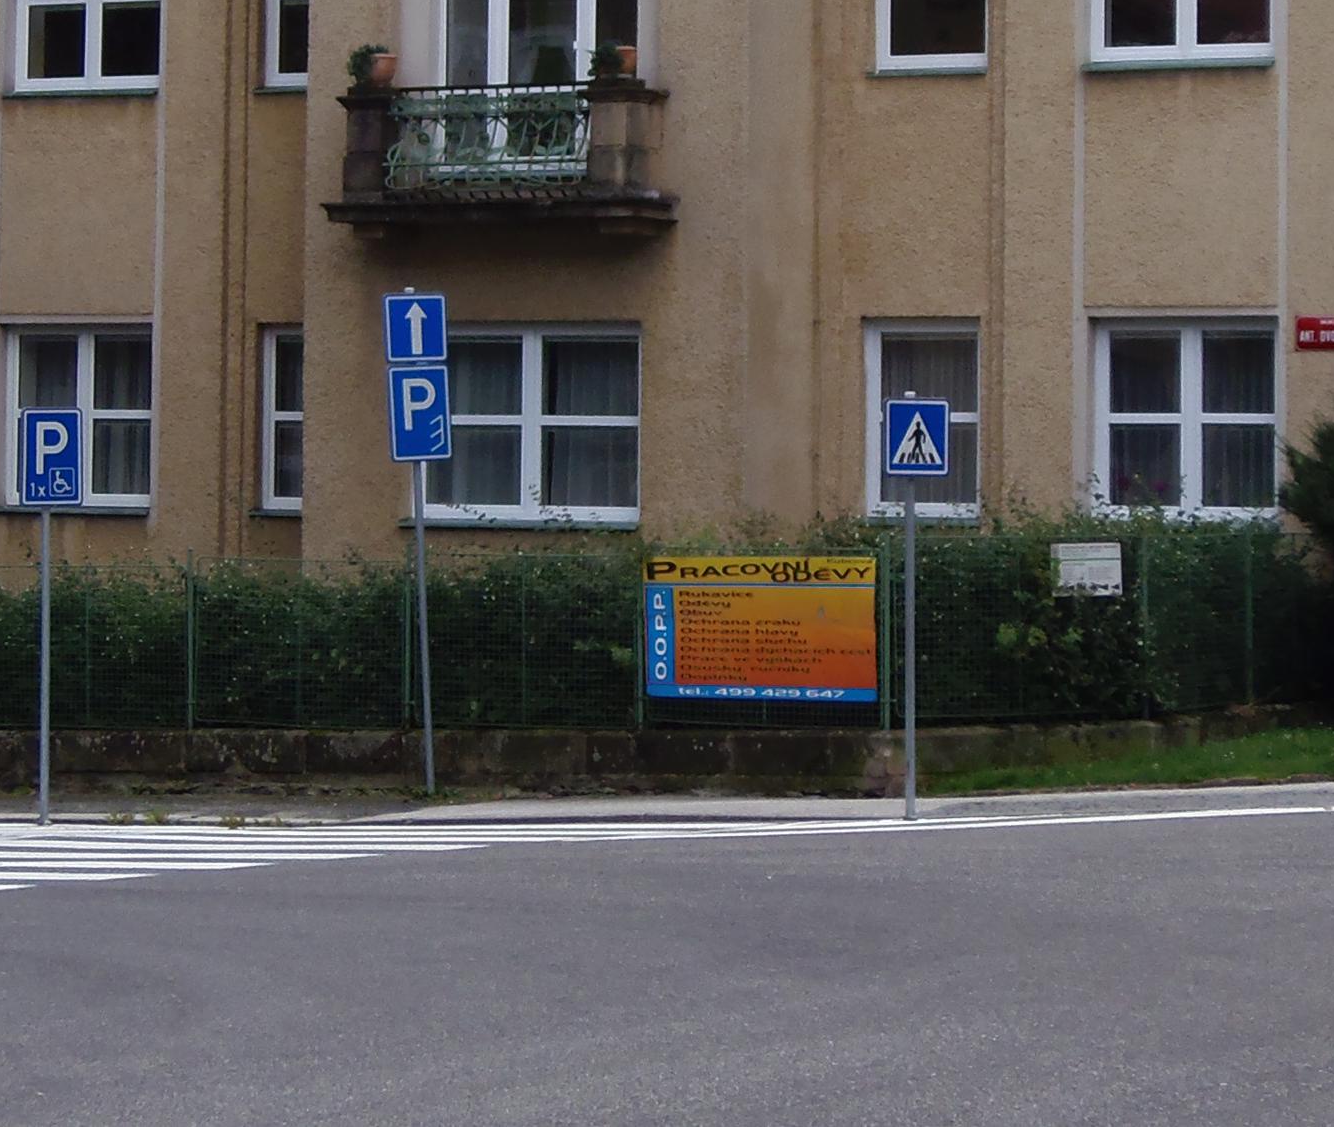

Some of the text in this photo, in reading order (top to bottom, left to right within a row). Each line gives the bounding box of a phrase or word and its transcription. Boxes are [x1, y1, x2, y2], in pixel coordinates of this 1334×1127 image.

[402, 378, 436, 430] P
[36, 420, 68, 475] P
[30, 482, 46, 498] 1x
[679, 590, 754, 598] Rukavice
[653, 591, 667, 680] O.O.P.P.
[714, 687, 757, 696] 499
[761, 688, 802, 697] 429
[805, 689, 845, 698] 647
